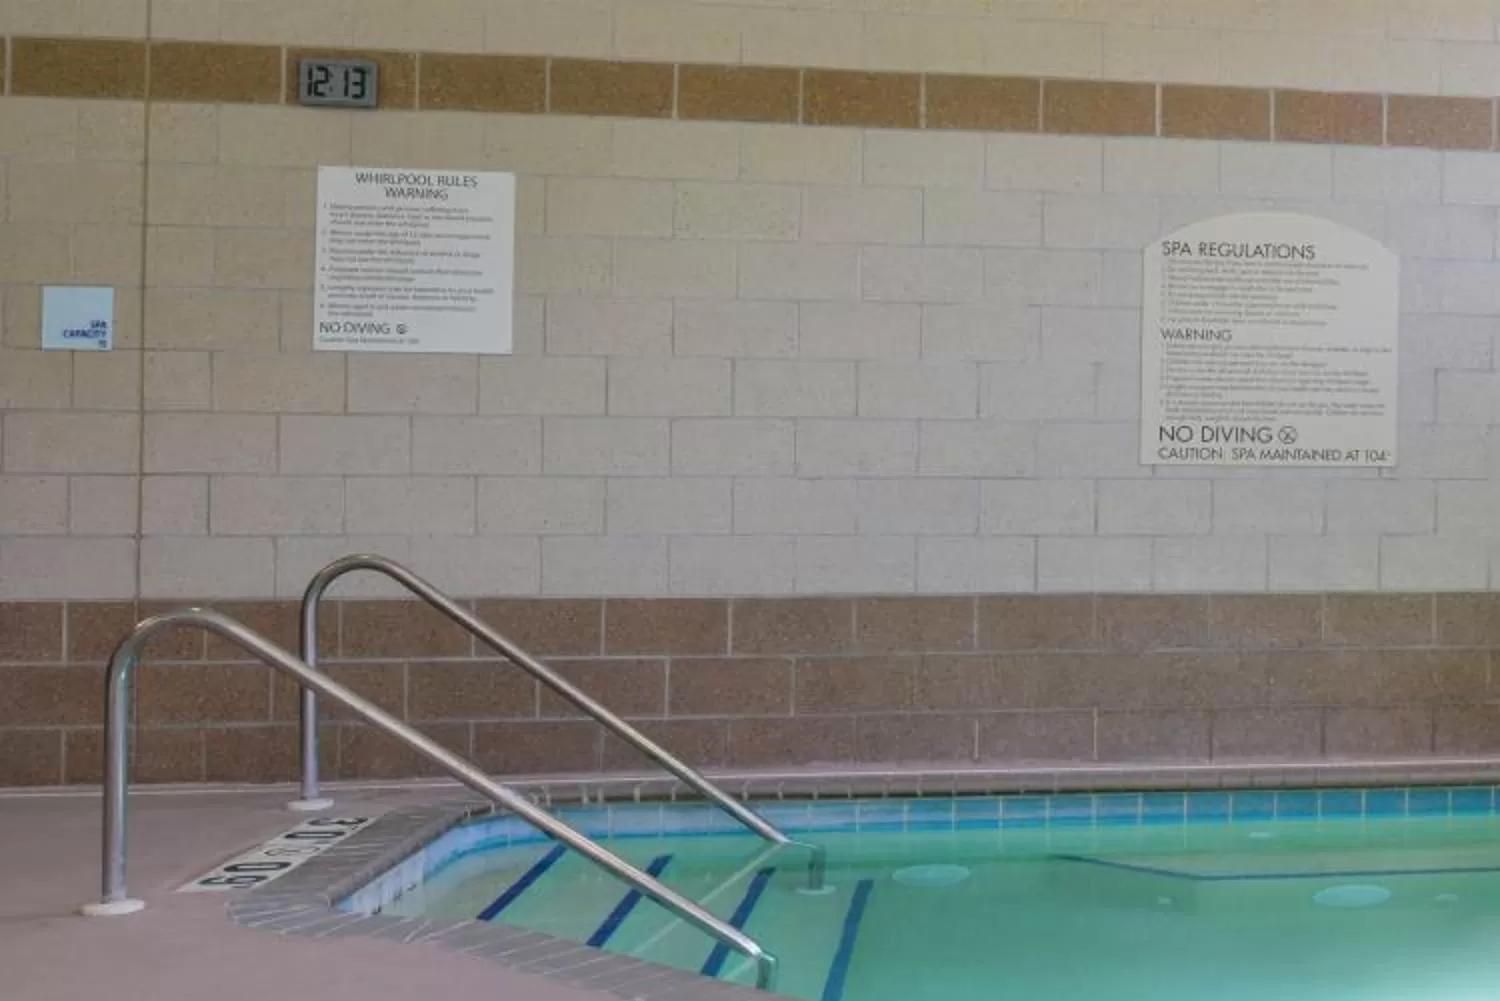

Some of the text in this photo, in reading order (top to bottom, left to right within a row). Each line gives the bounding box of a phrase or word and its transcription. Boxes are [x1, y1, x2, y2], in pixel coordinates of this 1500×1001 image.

[307, 65, 366, 99] 12:13
[355, 172, 478, 188] WHIRLPOOL RULES
[385, 187, 449, 200] WARNING
[1161, 240, 1316, 260] SPA REGULATIONS
[319, 321, 391, 335] NO DIVING
[1160, 328, 1232, 342] WARNING
[1159, 425, 1273, 445] NO DIVING
[1231, 447, 1257, 461] SPA
[1259, 449, 1342, 462] MAINTAINED
[1345, 449, 1360, 463] AT
